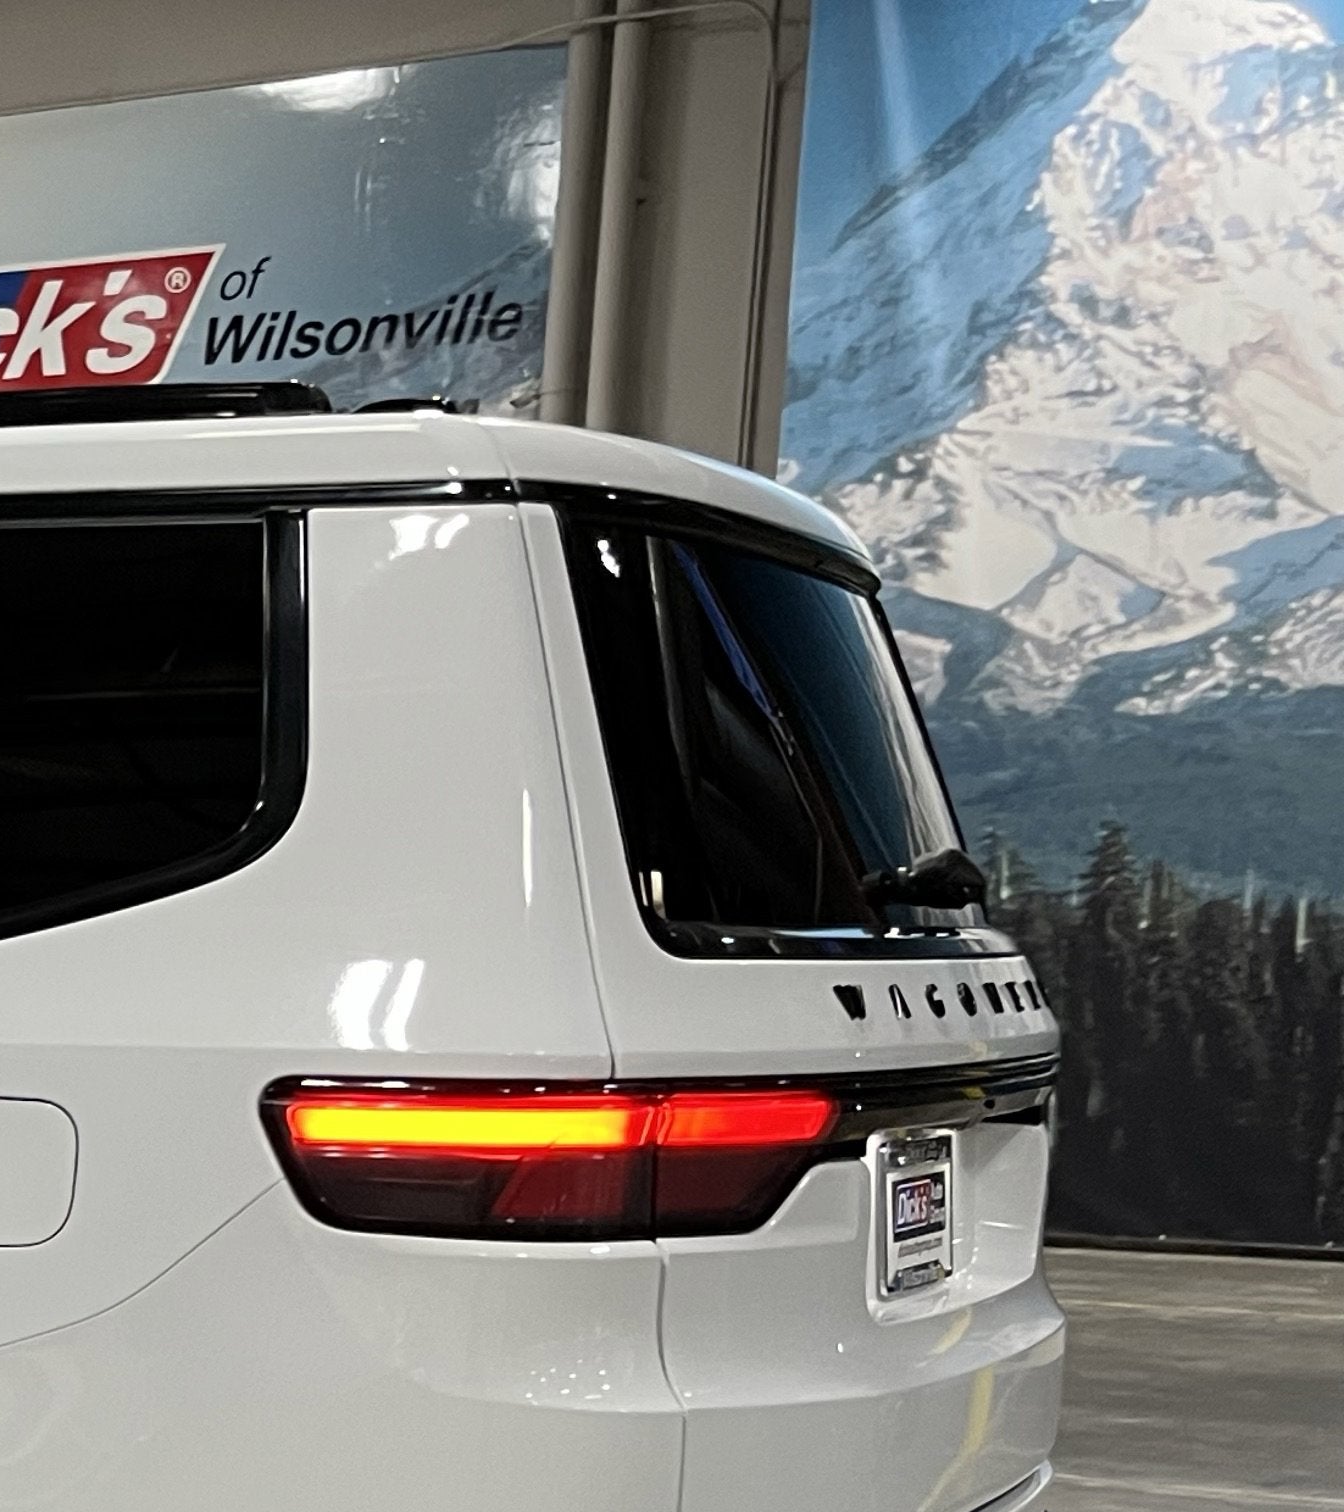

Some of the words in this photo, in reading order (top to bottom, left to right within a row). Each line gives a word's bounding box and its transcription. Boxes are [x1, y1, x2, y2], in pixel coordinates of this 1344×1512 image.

[219, 255, 272, 301] of
[203, 283, 524, 365] Wilsonville
[832, 979, 1050, 1021] WAGONEE
